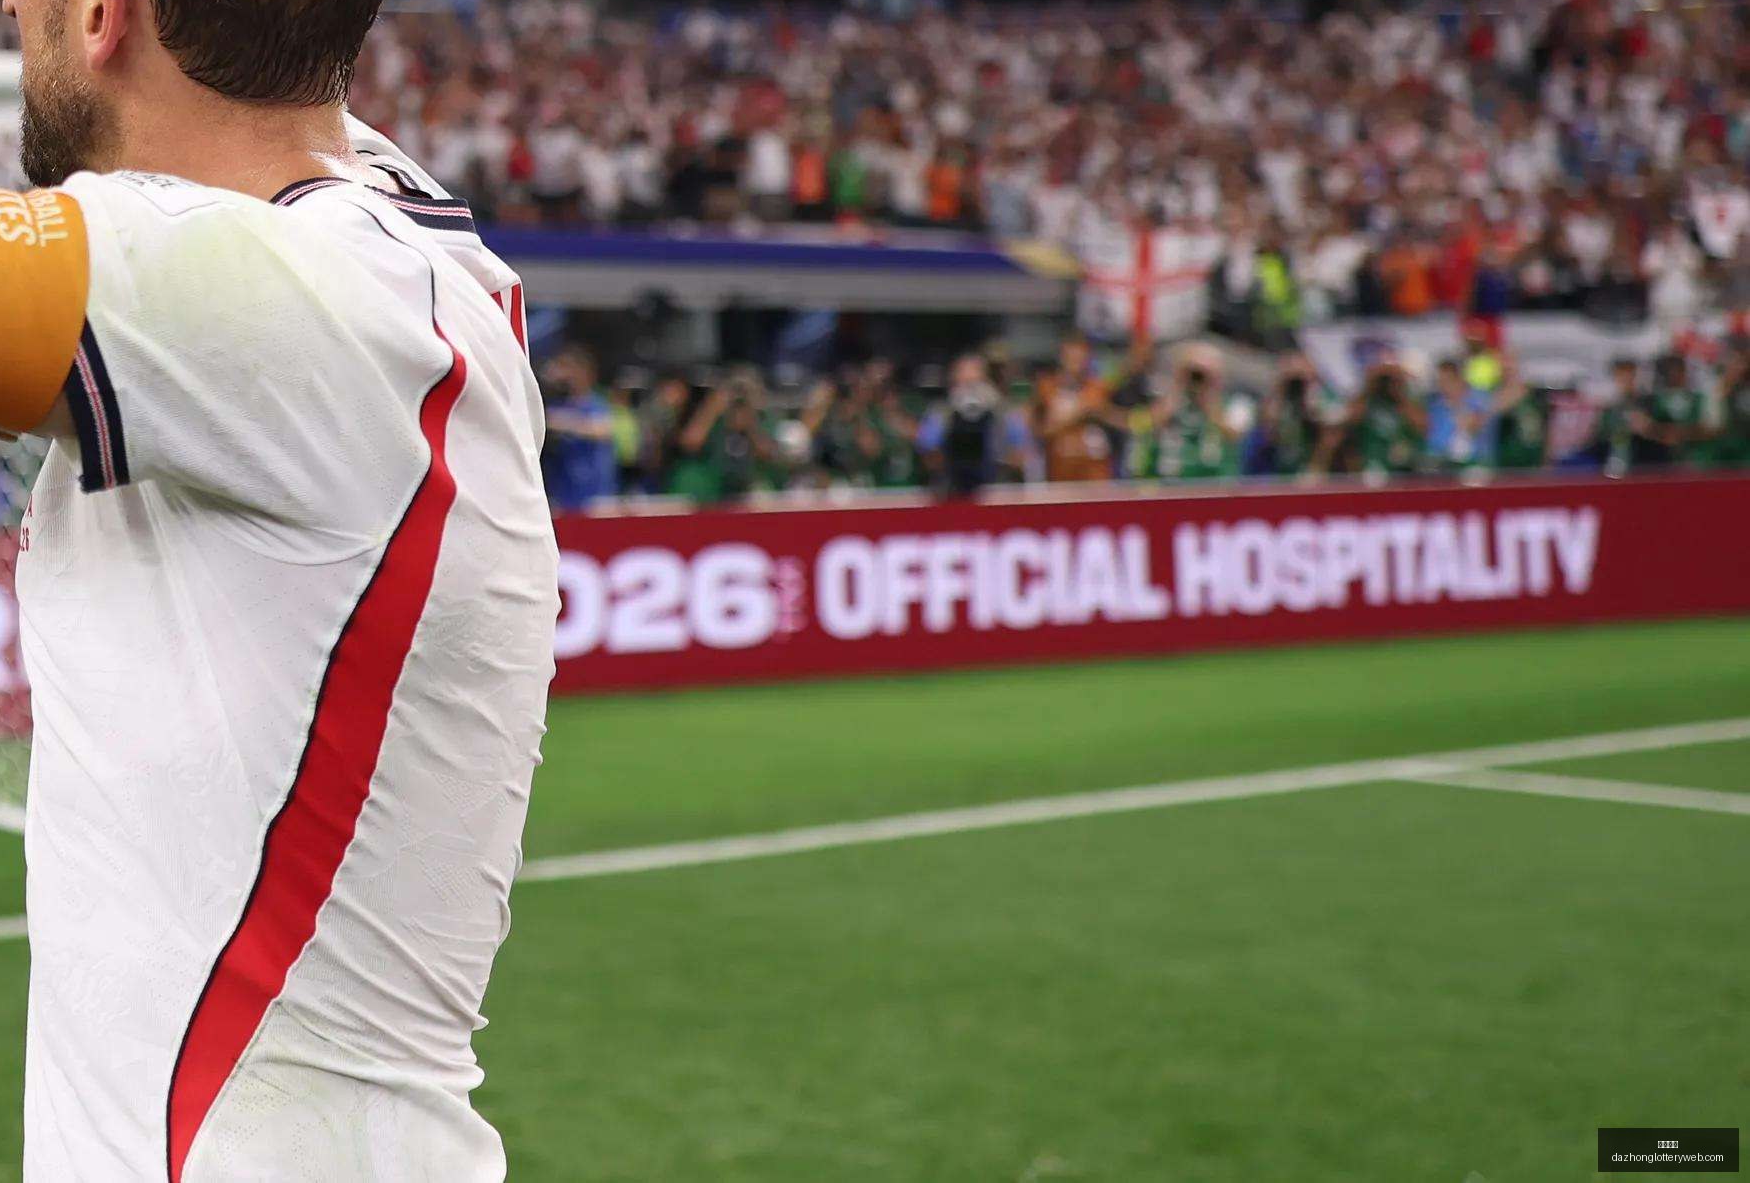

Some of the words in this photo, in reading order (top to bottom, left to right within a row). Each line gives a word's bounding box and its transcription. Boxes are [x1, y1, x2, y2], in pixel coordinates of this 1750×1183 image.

[27, 188, 69, 247] BALL
[553, 541, 778, 659] 026
[814, 523, 1171, 640] OFFICIAL
[1172, 505, 1601, 617] HOSPITALITY
